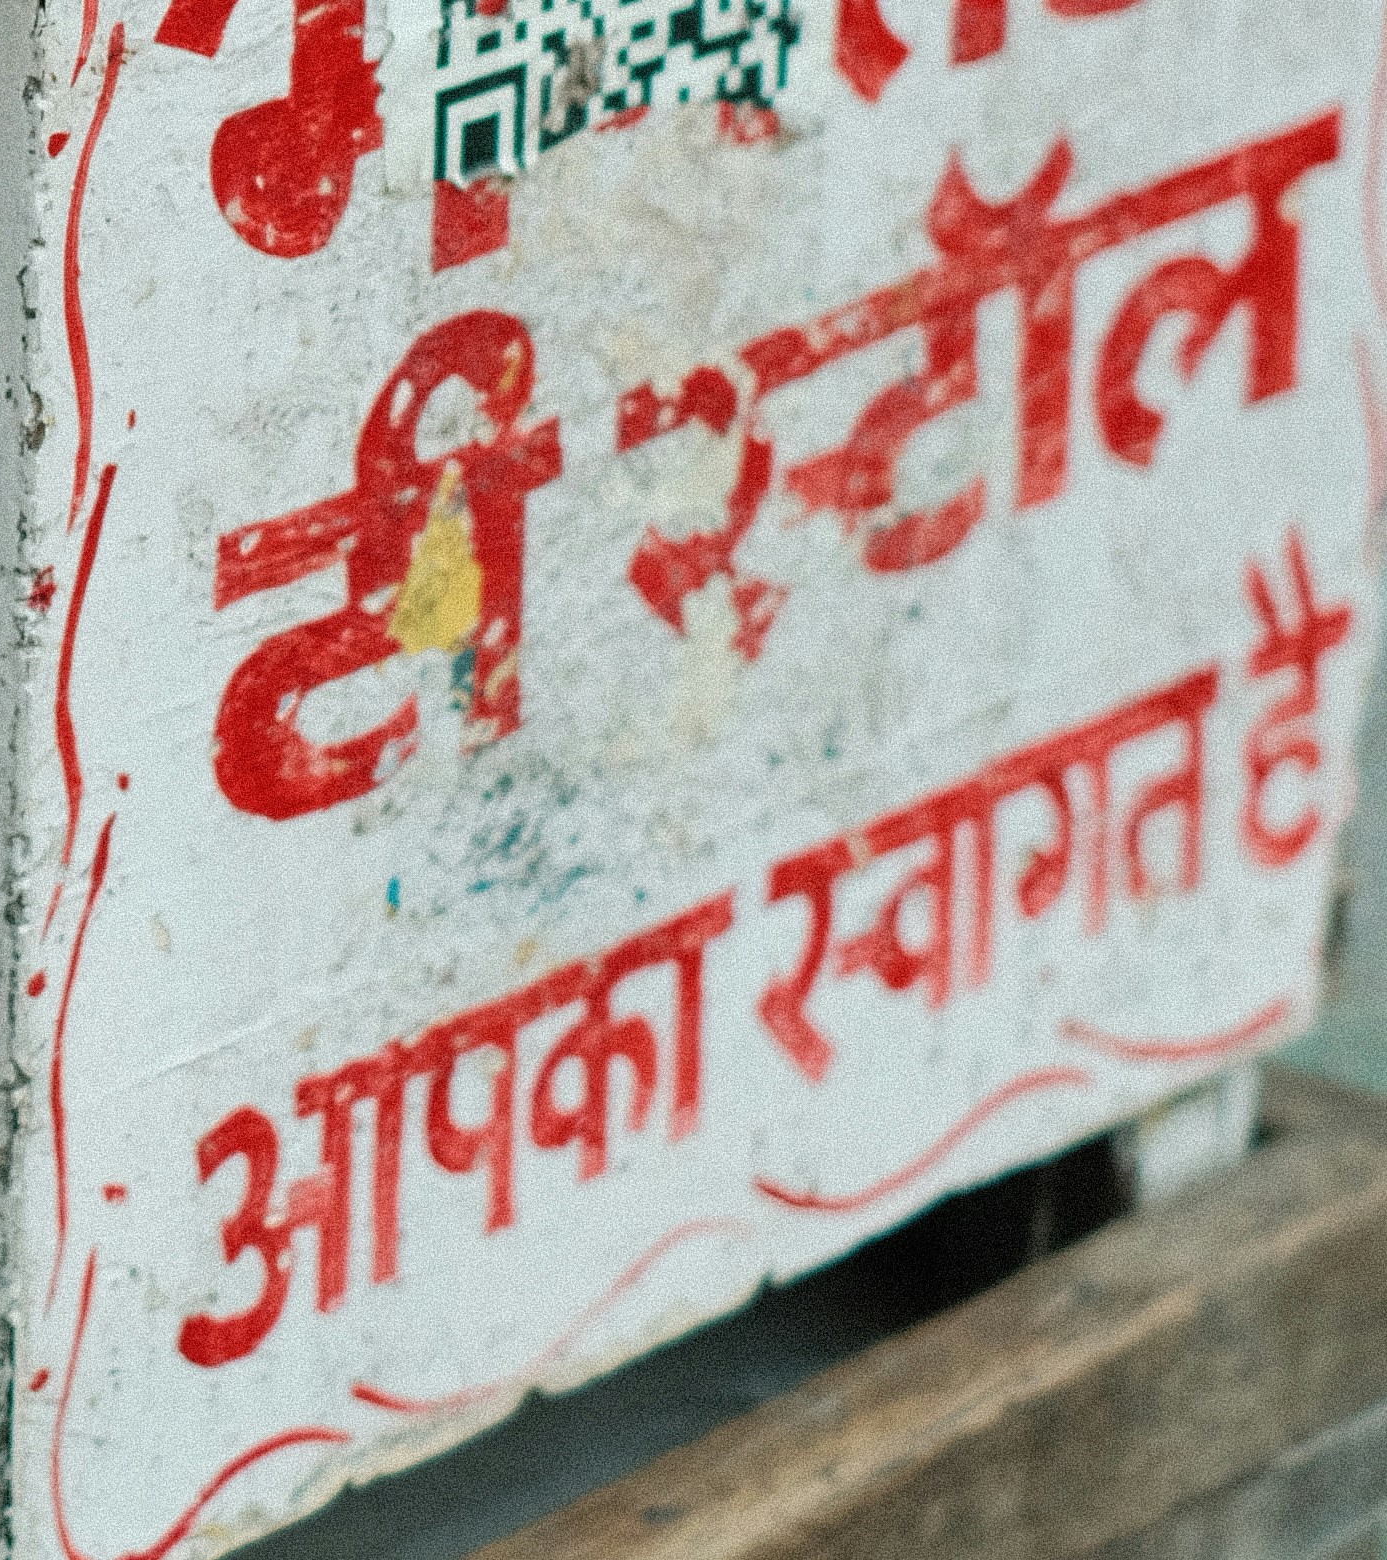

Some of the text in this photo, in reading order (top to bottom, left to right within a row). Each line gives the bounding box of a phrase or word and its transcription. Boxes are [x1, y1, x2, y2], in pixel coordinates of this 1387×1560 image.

[212, 309, 564, 822] टी
[177, 892, 735, 1368] आपका
[757, 662, 1221, 1078] स्वागत
